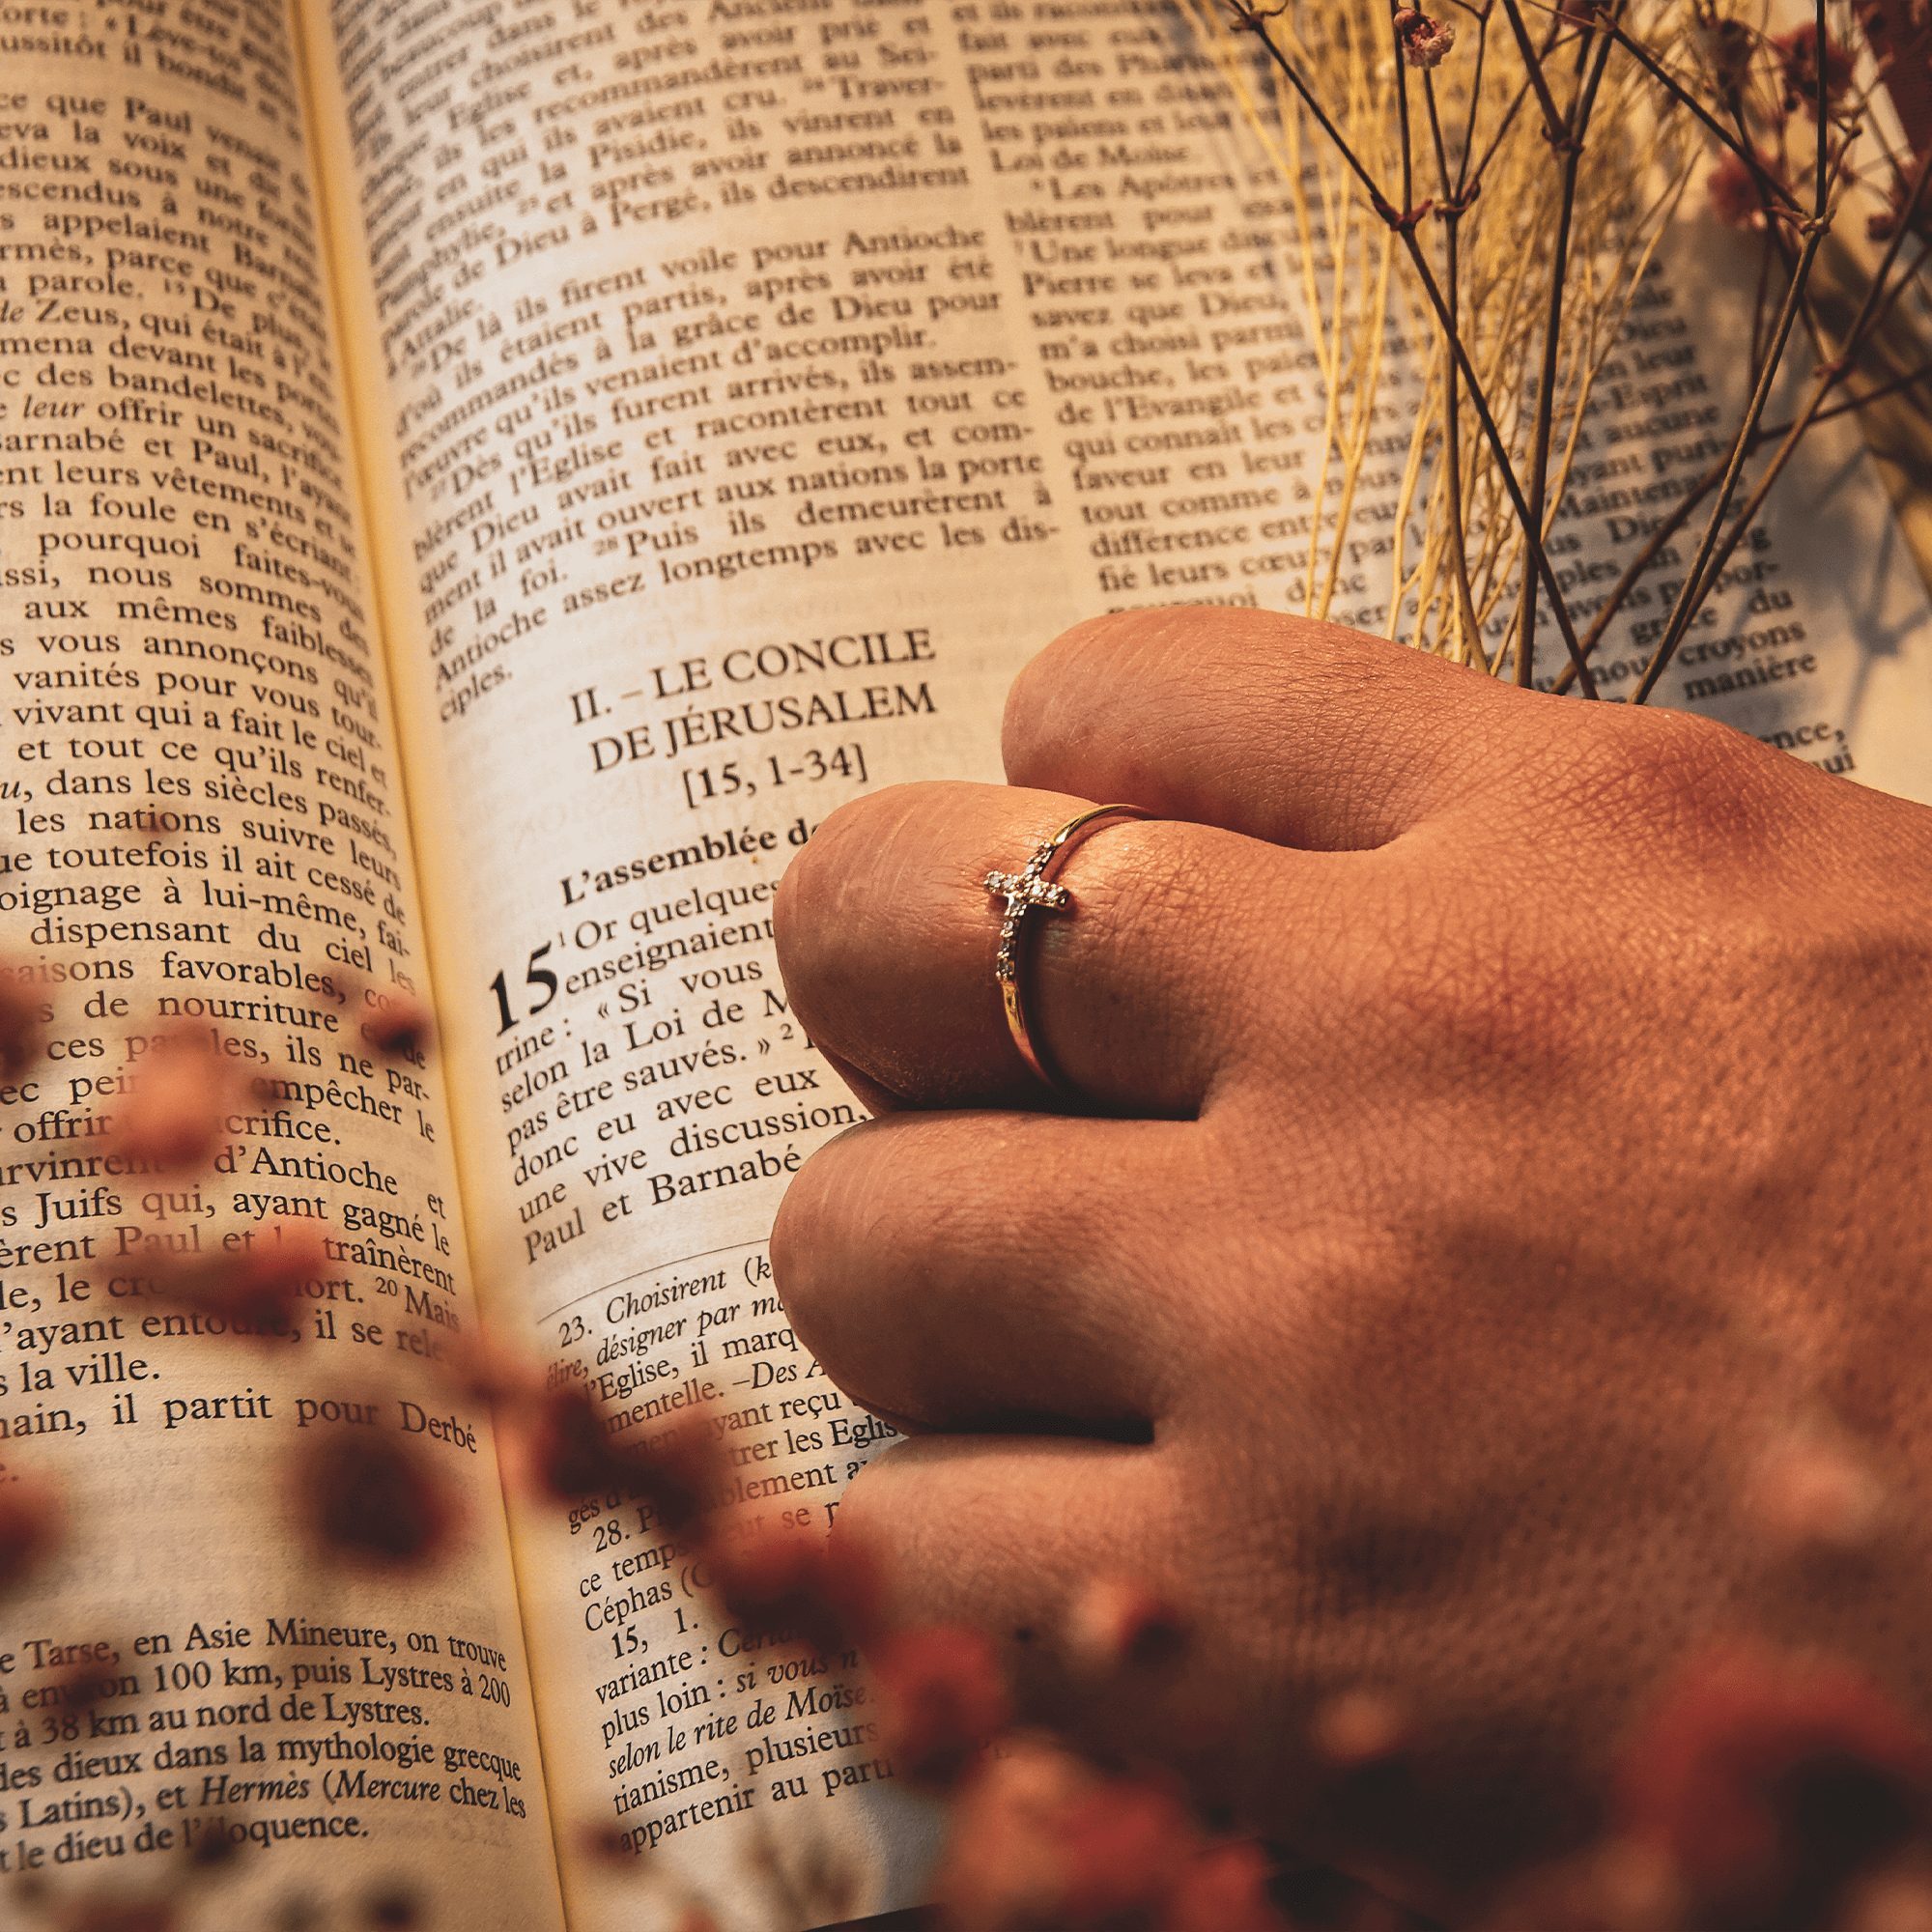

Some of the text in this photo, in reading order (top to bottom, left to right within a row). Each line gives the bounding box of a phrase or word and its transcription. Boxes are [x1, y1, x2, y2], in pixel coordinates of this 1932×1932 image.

[46, 97, 191, 134] que Paul
[0, 147, 90, 172] dieux
[753, 227, 985, 270] pour Antioche
[37, 299, 129, 329] Zeus,
[23, 395, 182, 427] leur offrir
[697, 391, 1024, 439] racontèrent tout ce
[44, 493, 175, 522] la foule
[797, 491, 1005, 526] demeurèrent
[1082, 490, 1275, 524] tout comme
[40, 534, 199, 558] pourquoi
[661, 518, 1057, 583] longtemps avec les dis-
[1092, 526, 1248, 557] différence
[89, 568, 321, 622] nous sommes
[1679, 622, 1804, 667] croyons
[14, 663, 236, 696] vanités pour
[570, 686, 611, 724] II.
[649, 659, 713, 698] LE
[723, 630, 937, 681] CONCILE
[1684, 654, 1817, 699] manière
[588, 683, 938, 771] DE JÉRUSALEM
[18, 739, 301, 778] et tout ce qu'ils
[682, 744, 867, 809] [15, 1-34]
[46, 769, 307, 813] dans les siècles
[17, 804, 333, 855] les nations suivre
[560, 826, 776, 905] L'assemblée
[164, 879, 409, 955] à lui-même, fai-
[576, 922, 616, 949] Or
[31, 918, 372, 972] dispensant du ciel
[566, 918, 776, 994] enseignaient
[161, 952, 346, 1005] favorables,
[490, 940, 561, 1036] 15
[619, 980, 651, 1012] Si
[681, 962, 762, 992] vous
[85, 990, 338, 1033] de nourriture
[286, 1036, 429, 1099] ils ne par-
[502, 1000, 743, 1113] selon la Loi de
[506, 1039, 747, 1157] pas être sauvés.
[515, 1070, 819, 1186] donc eu avec eux
[214, 1146, 445, 1219] d'Antioche et
[518, 1101, 869, 1223] une vive discussion,
[36, 1185, 449, 1256] Juifs qui, ayant gagné le
[524, 1145, 802, 1264] Paul et Barnabé
[323, 1237, 455, 1295] traînèrent
[559, 1271, 725, 1348] 23. Choisirent
[597, 1304, 740, 1366] désigner par
[20, 1354, 159, 1392] la ville.
[113, 1388, 476, 1453] il partit pour Derbé
[780, 1393, 841, 1419] reçu
[593, 1520, 630, 1552] 28.
[585, 1582, 672, 1631] Céphas
[24, 1618, 506, 1671] Tarse, en Asie Mineure, on trouve
[612, 1607, 697, 1659] 15, 1.
[156, 1657, 510, 1707] 100 km, puis Lystres à 200
[596, 1652, 692, 1704] variante
[602, 1654, 829, 1747] plus loin si vous
[88, 1693, 429, 1739] km au nord de Lystres.
[610, 1742, 660, 1778] selon
[668, 1726, 686, 1754] le
[695, 1713, 737, 1744] rite
[748, 1699, 776, 1729] de
[53, 1732, 521, 1782] dieux dans la mythologie grecque
[613, 1721, 880, 1815] tianisme, plusieurs
[19, 1770, 526, 1829] Latins), et Hermès (Mercure chez les
[618, 1788, 754, 1854] appartenir
[772, 1776, 808, 1801] au
